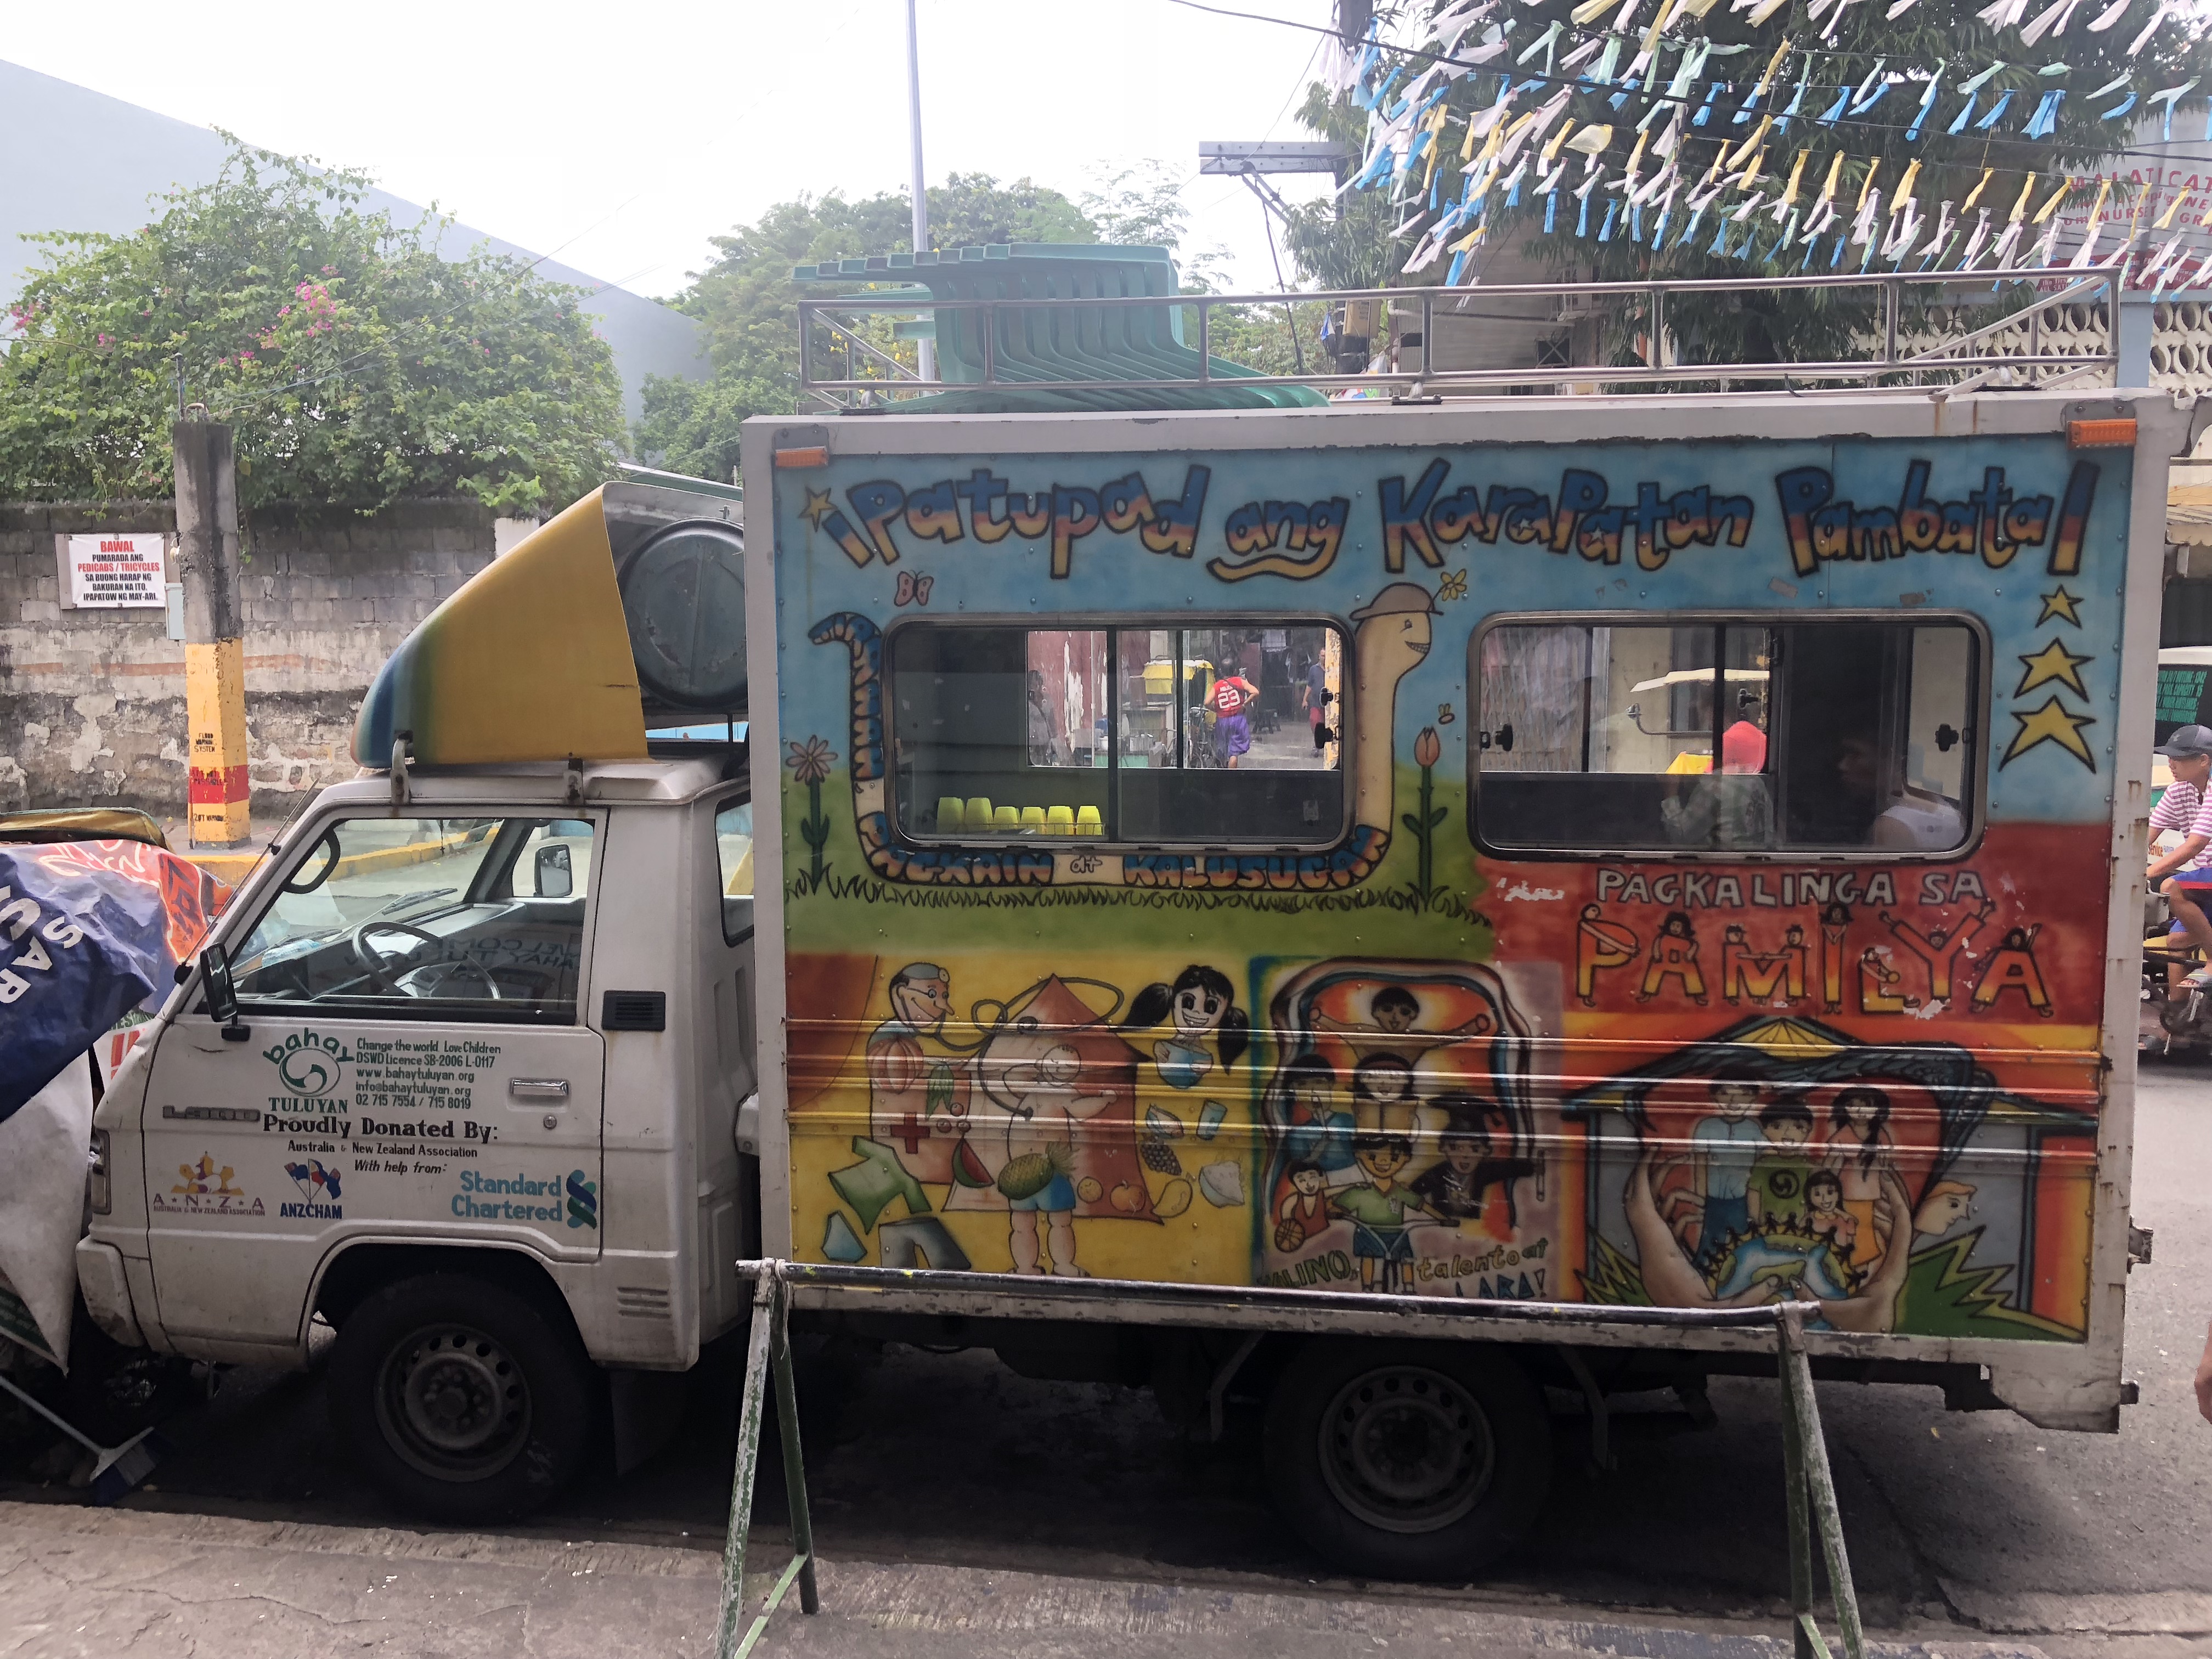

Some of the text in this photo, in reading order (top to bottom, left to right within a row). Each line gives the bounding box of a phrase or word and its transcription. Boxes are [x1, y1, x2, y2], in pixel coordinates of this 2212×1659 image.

[100, 540, 134, 552] BAWAL
[1207, 496, 1350, 583] ang
[92, 554, 143, 562] PUMARADA ANG
[77, 563, 114, 572] PEDICABS
[121, 562, 160, 572] TRICYCLES
[95, 573, 118, 582] BUONG
[92, 583, 123, 591] BAKURAN
[83, 592, 117, 601] IPAPATOW
[129, 592, 158, 601] MAY-ARI.
[1217, 689, 1240, 709] 23
[1122, 824, 1388, 890] KALUSUGAN
[1596, 870, 1985, 906] PAGKALINGA SA
[1576, 901, 2055, 1016] PAMILYA
[357, 1037, 393, 1052] Change
[395, 1039, 411, 1052] the
[444, 1040, 462, 1053] Love
[463, 1041, 501, 1054] Children
[357, 1052, 495, 1068] DSWD Licence SB-2006 L-0117
[269, 1097, 348, 1114] TULUYAN
[356, 1093, 369, 1105] 02
[372, 1094, 388, 1106] 715
[392, 1094, 416, 1107] 7554
[428, 1096, 445, 1108] 715
[447, 1097, 471, 1109] 8019
[263, 1114, 498, 1144] Proudly Donated By:
[287, 1140, 335, 1153] Australia
[352, 1142, 374, 1154] New
[376, 1143, 415, 1156] Zealand
[418, 1146, 477, 1158] Association
[354, 1160, 447, 1175] With help from:
[460, 1170, 561, 1197] Standard
[229, 1209, 265, 1217] ASSOCIATION
[280, 1202, 342, 1220] ANZCHAM
[452, 1194, 562, 1221] Chartered
[1417, 1245, 1520, 1282] talento
